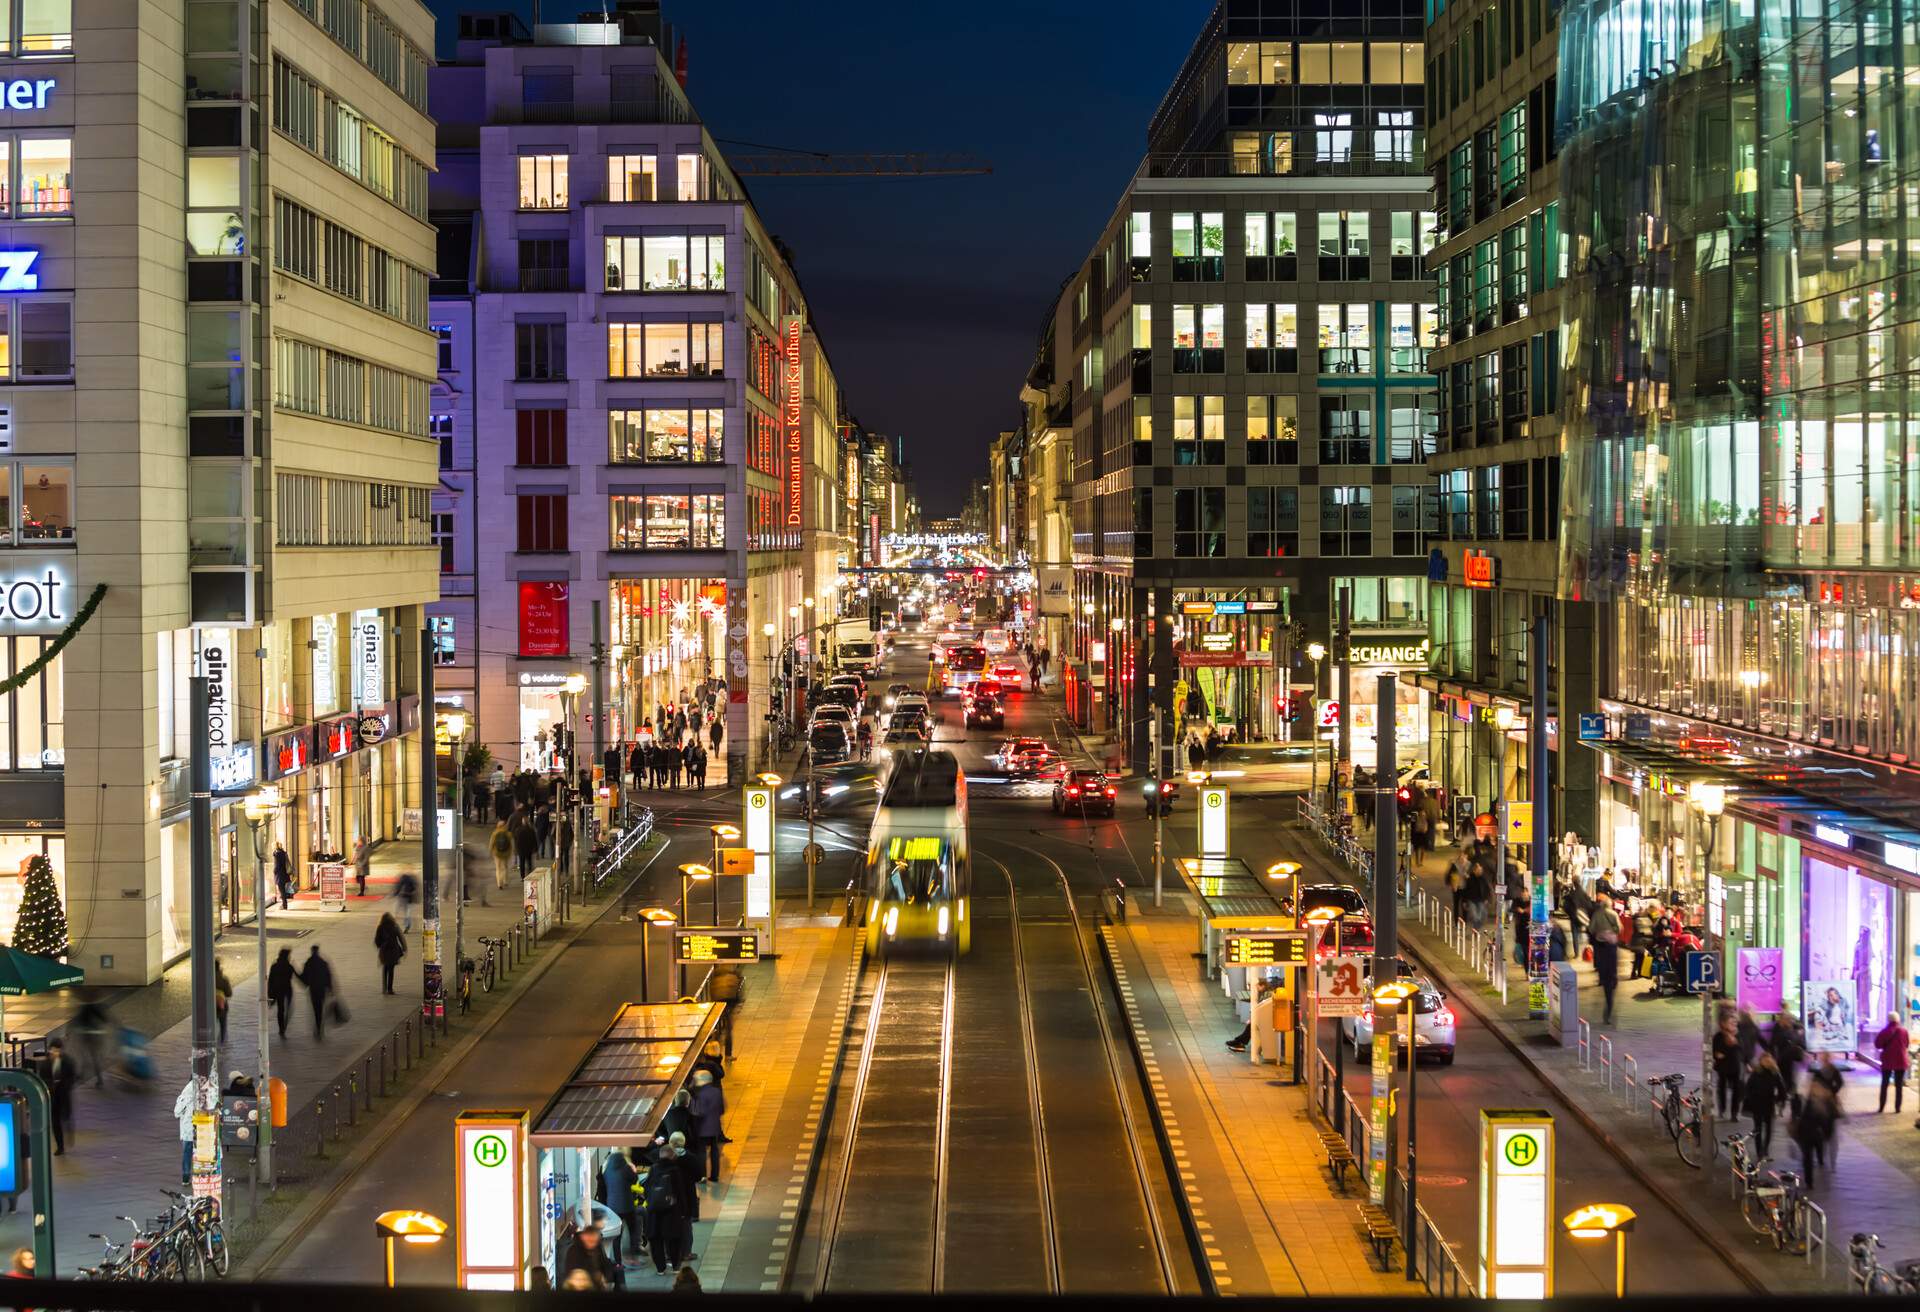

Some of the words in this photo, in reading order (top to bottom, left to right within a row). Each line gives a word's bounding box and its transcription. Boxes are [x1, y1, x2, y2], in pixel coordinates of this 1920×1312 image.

[0, 79, 56, 110] er
[786, 320, 802, 426] KulturKaufhaus
[788, 429, 802, 453] das
[788, 456, 802, 526] Dussmann
[362, 624, 380, 703] ginatricot
[1701, 962, 1713, 982] P
